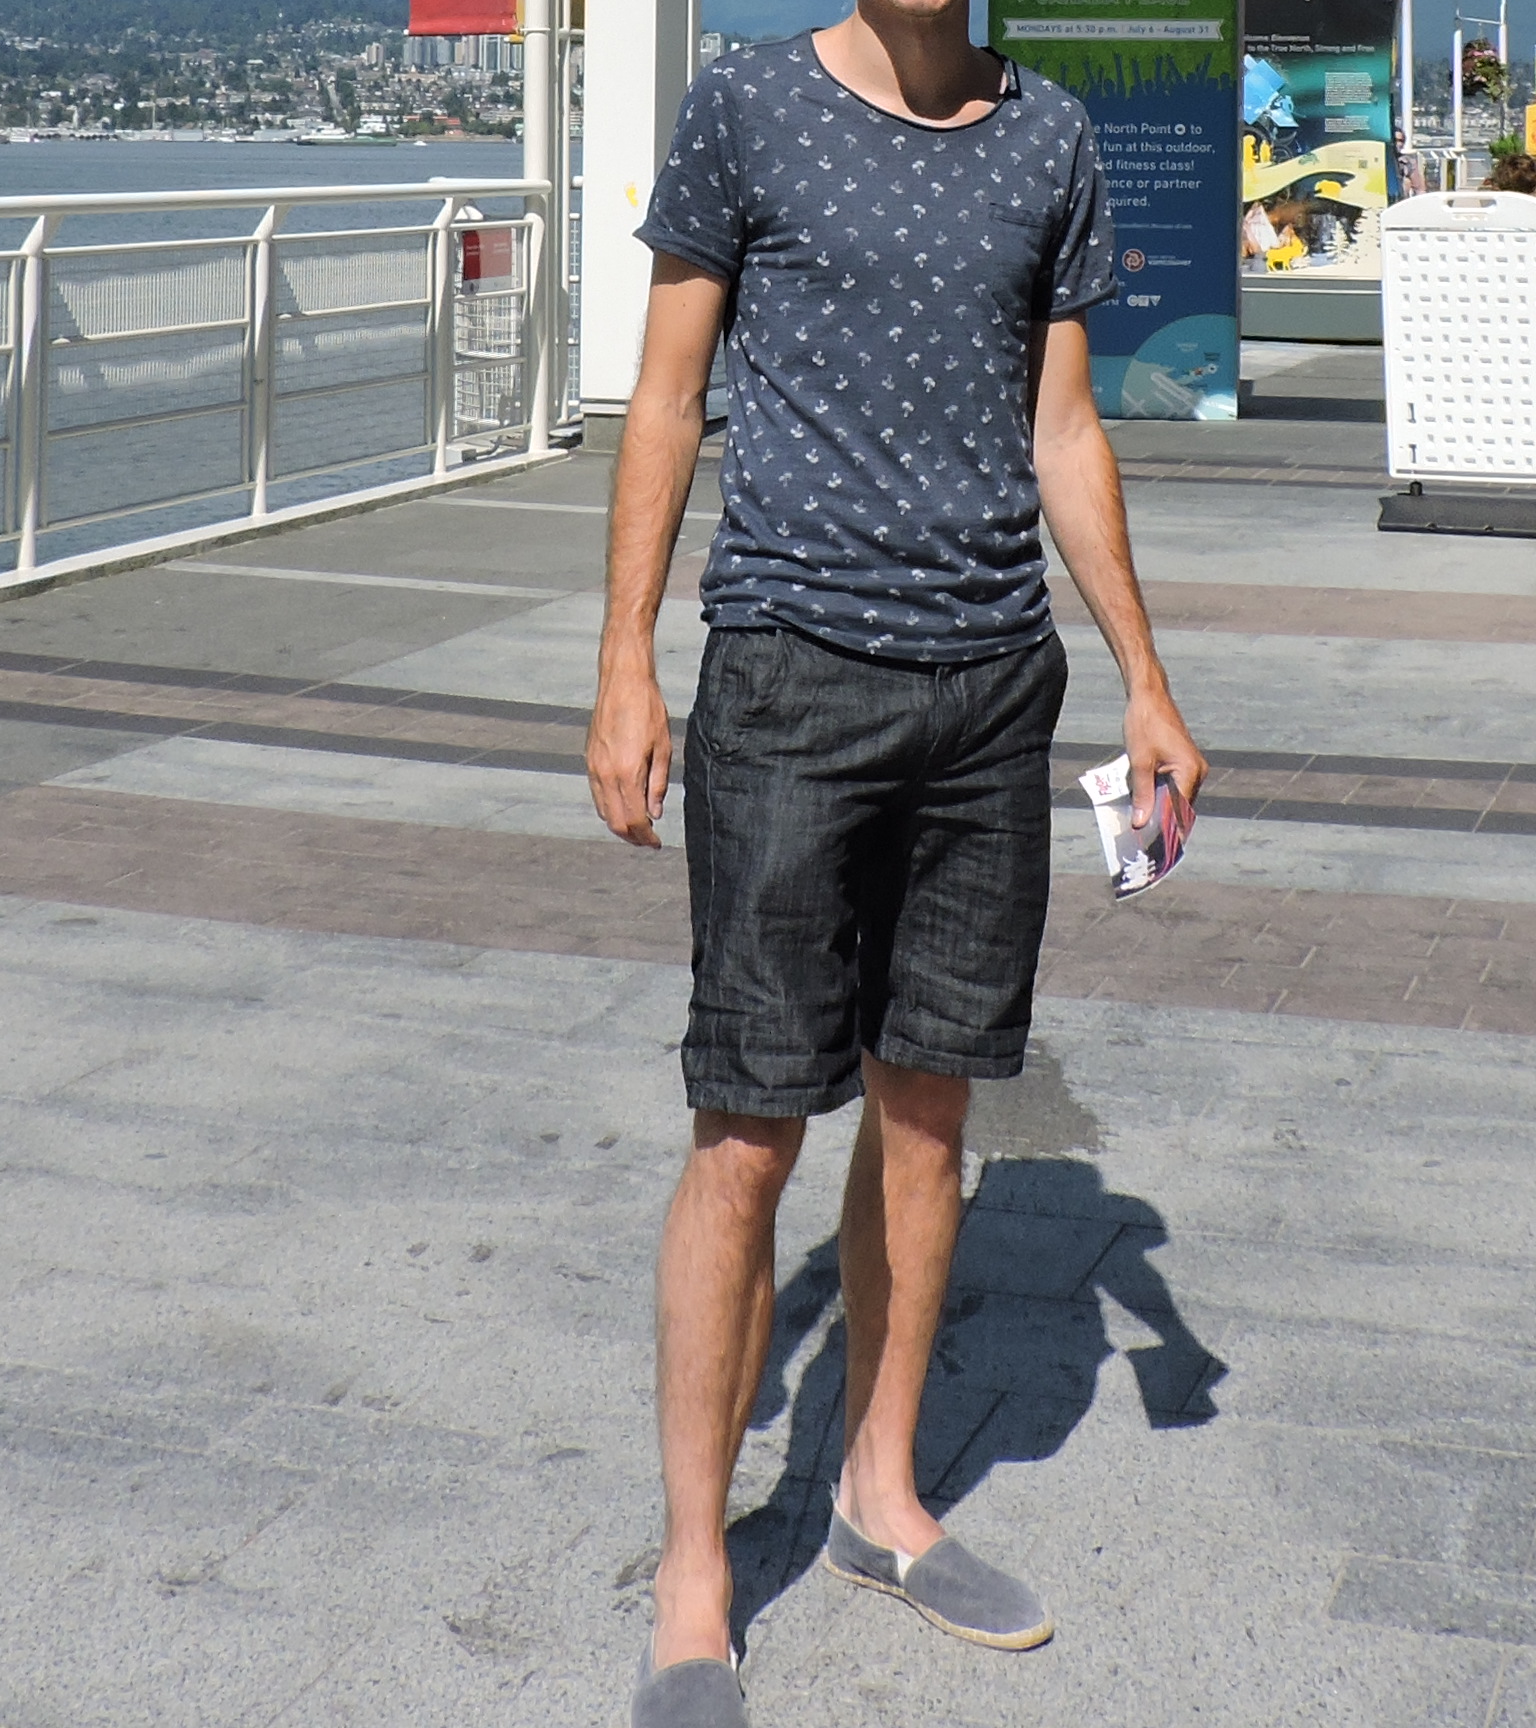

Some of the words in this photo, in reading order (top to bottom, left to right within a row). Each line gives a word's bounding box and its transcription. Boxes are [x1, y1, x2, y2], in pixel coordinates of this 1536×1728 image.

[1016, 25, 1062, 34] MONDAYS
[1127, 25, 1146, 35] July
[1164, 25, 1195, 35] August
[1104, 123, 1137, 134] North
[1190, 124, 1202, 135] to
[1104, 141, 1123, 152] fun
[1126, 142, 1137, 152] at
[1140, 142, 1162, 152] this
[1166, 142, 1215, 154] outdoor,
[1116, 160, 1156, 171] fitness
[1159, 160, 1194, 171] class!
[1137, 180, 1150, 189] or
[1154, 179, 1202, 191] partner
[1107, 196, 1151, 208] quired.
